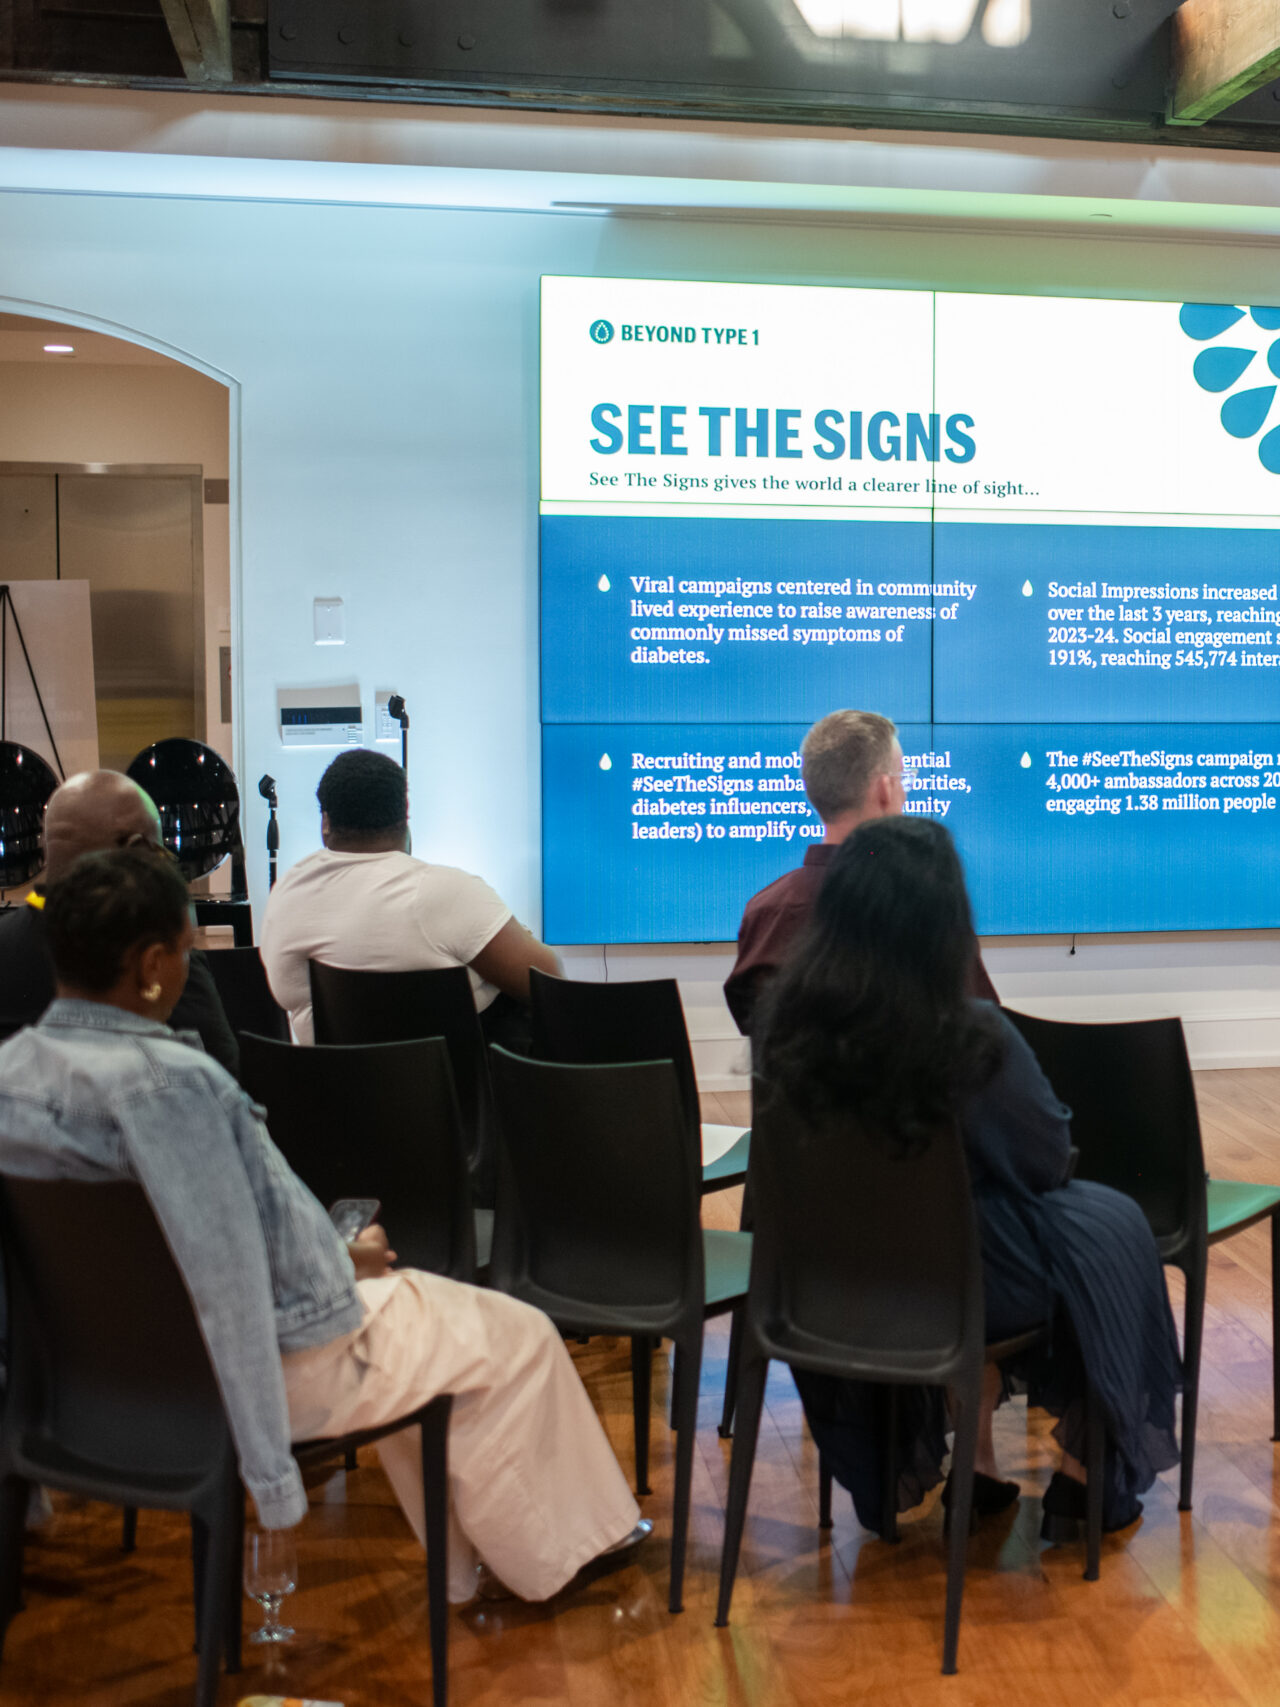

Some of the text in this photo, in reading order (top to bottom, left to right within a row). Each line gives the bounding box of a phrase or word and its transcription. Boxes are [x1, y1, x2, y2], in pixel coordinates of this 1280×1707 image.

[622, 325, 758, 345] BEYOND TYPE 1
[590, 403, 977, 464] SEE THE SIGNS
[590, 473, 1038, 497] See The Signs gives the world a clearer line of sight...
[630, 576, 976, 600] Viral campaigns centered in community
[1049, 582, 1097, 598] Social
[1102, 583, 1198, 602] Impressions
[1203, 584, 1277, 600] increased
[631, 600, 959, 621] lived experience to raise awareness of
[1048, 609, 1084, 620] over
[1088, 605, 1114, 621] the
[1119, 605, 1148, 621] last
[1153, 607, 1162, 621] 3
[1166, 610, 1212, 625] years,
[631, 624, 904, 645] commonly missed symptoms of
[1048, 628, 1118, 643] 2023-24.
[1124, 628, 1171, 643] Social
[1175, 631, 1272, 648] engagement
[631, 647, 709, 663] diabetes.
[1050, 651, 1096, 668] 191%,
[1101, 650, 1172, 669] reaching
[1175, 651, 1237, 668] 545,774
[632, 753, 725, 772] Recruiting
[728, 752, 761, 768] and
[903, 752, 950, 770] ential
[1047, 751, 1078, 766] The
[1083, 751, 1193, 770] #SeeTheSigns
[1197, 751, 1273, 769] campaign
[633, 775, 753, 795] #SeeTheSigns
[912, 774, 971, 793] brities,
[1046, 774, 1100, 792] 4,000+
[1105, 773, 1206, 788] ambassadors
[1211, 776, 1259, 787] across
[632, 797, 950, 816] diabetes influencers, unity
[1046, 794, 1275, 815] engaging 1.38 million people
[633, 822, 702, 842] leaders)
[706, 824, 725, 838] to
[729, 821, 796, 841] amplify
